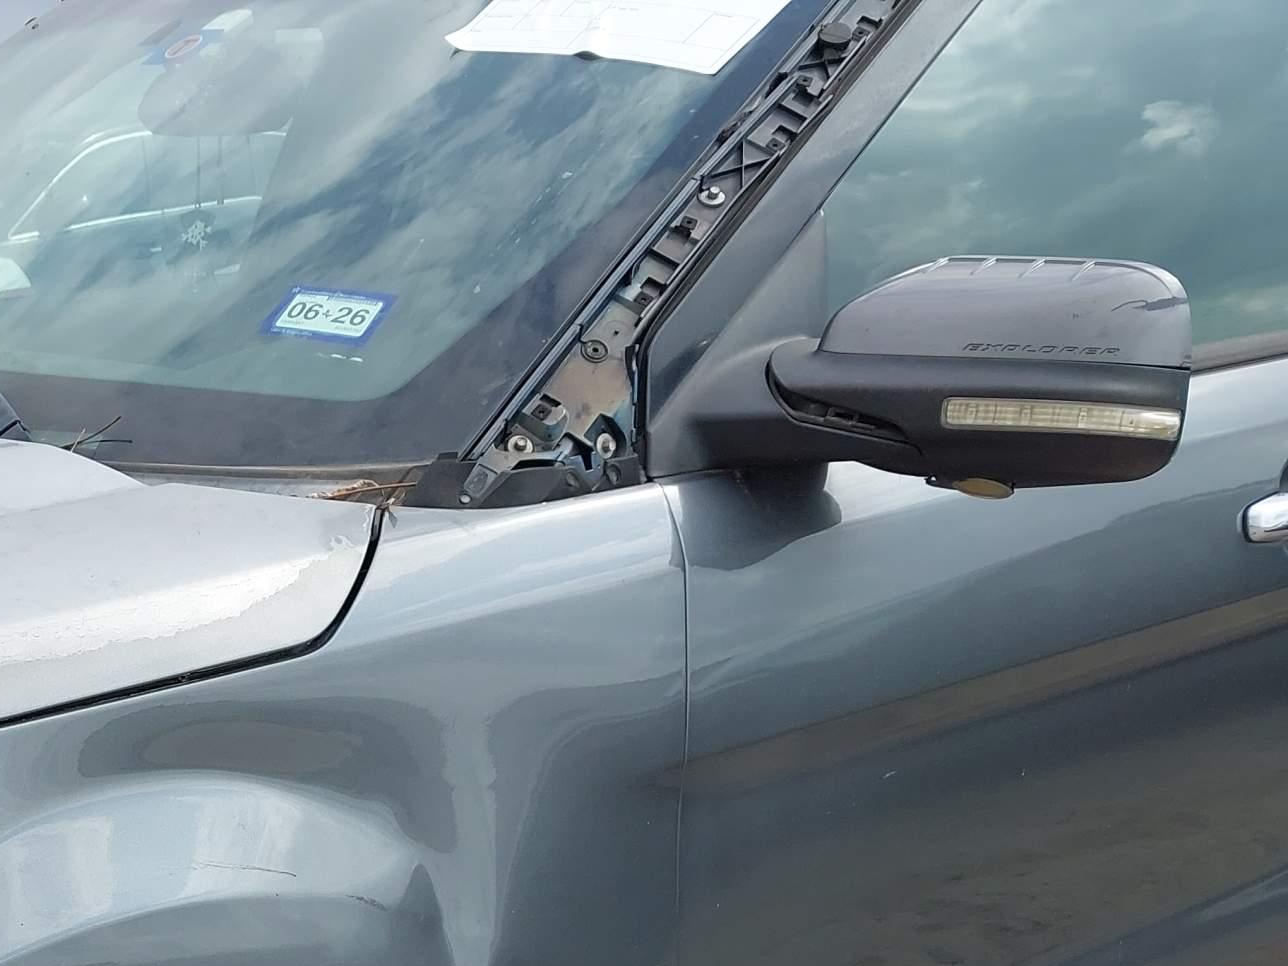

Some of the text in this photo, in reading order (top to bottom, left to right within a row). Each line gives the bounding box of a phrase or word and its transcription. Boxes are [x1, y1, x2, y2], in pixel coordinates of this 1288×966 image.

[287, 302, 370, 326] 06 26
[963, 343, 1120, 356] EXPLORER
